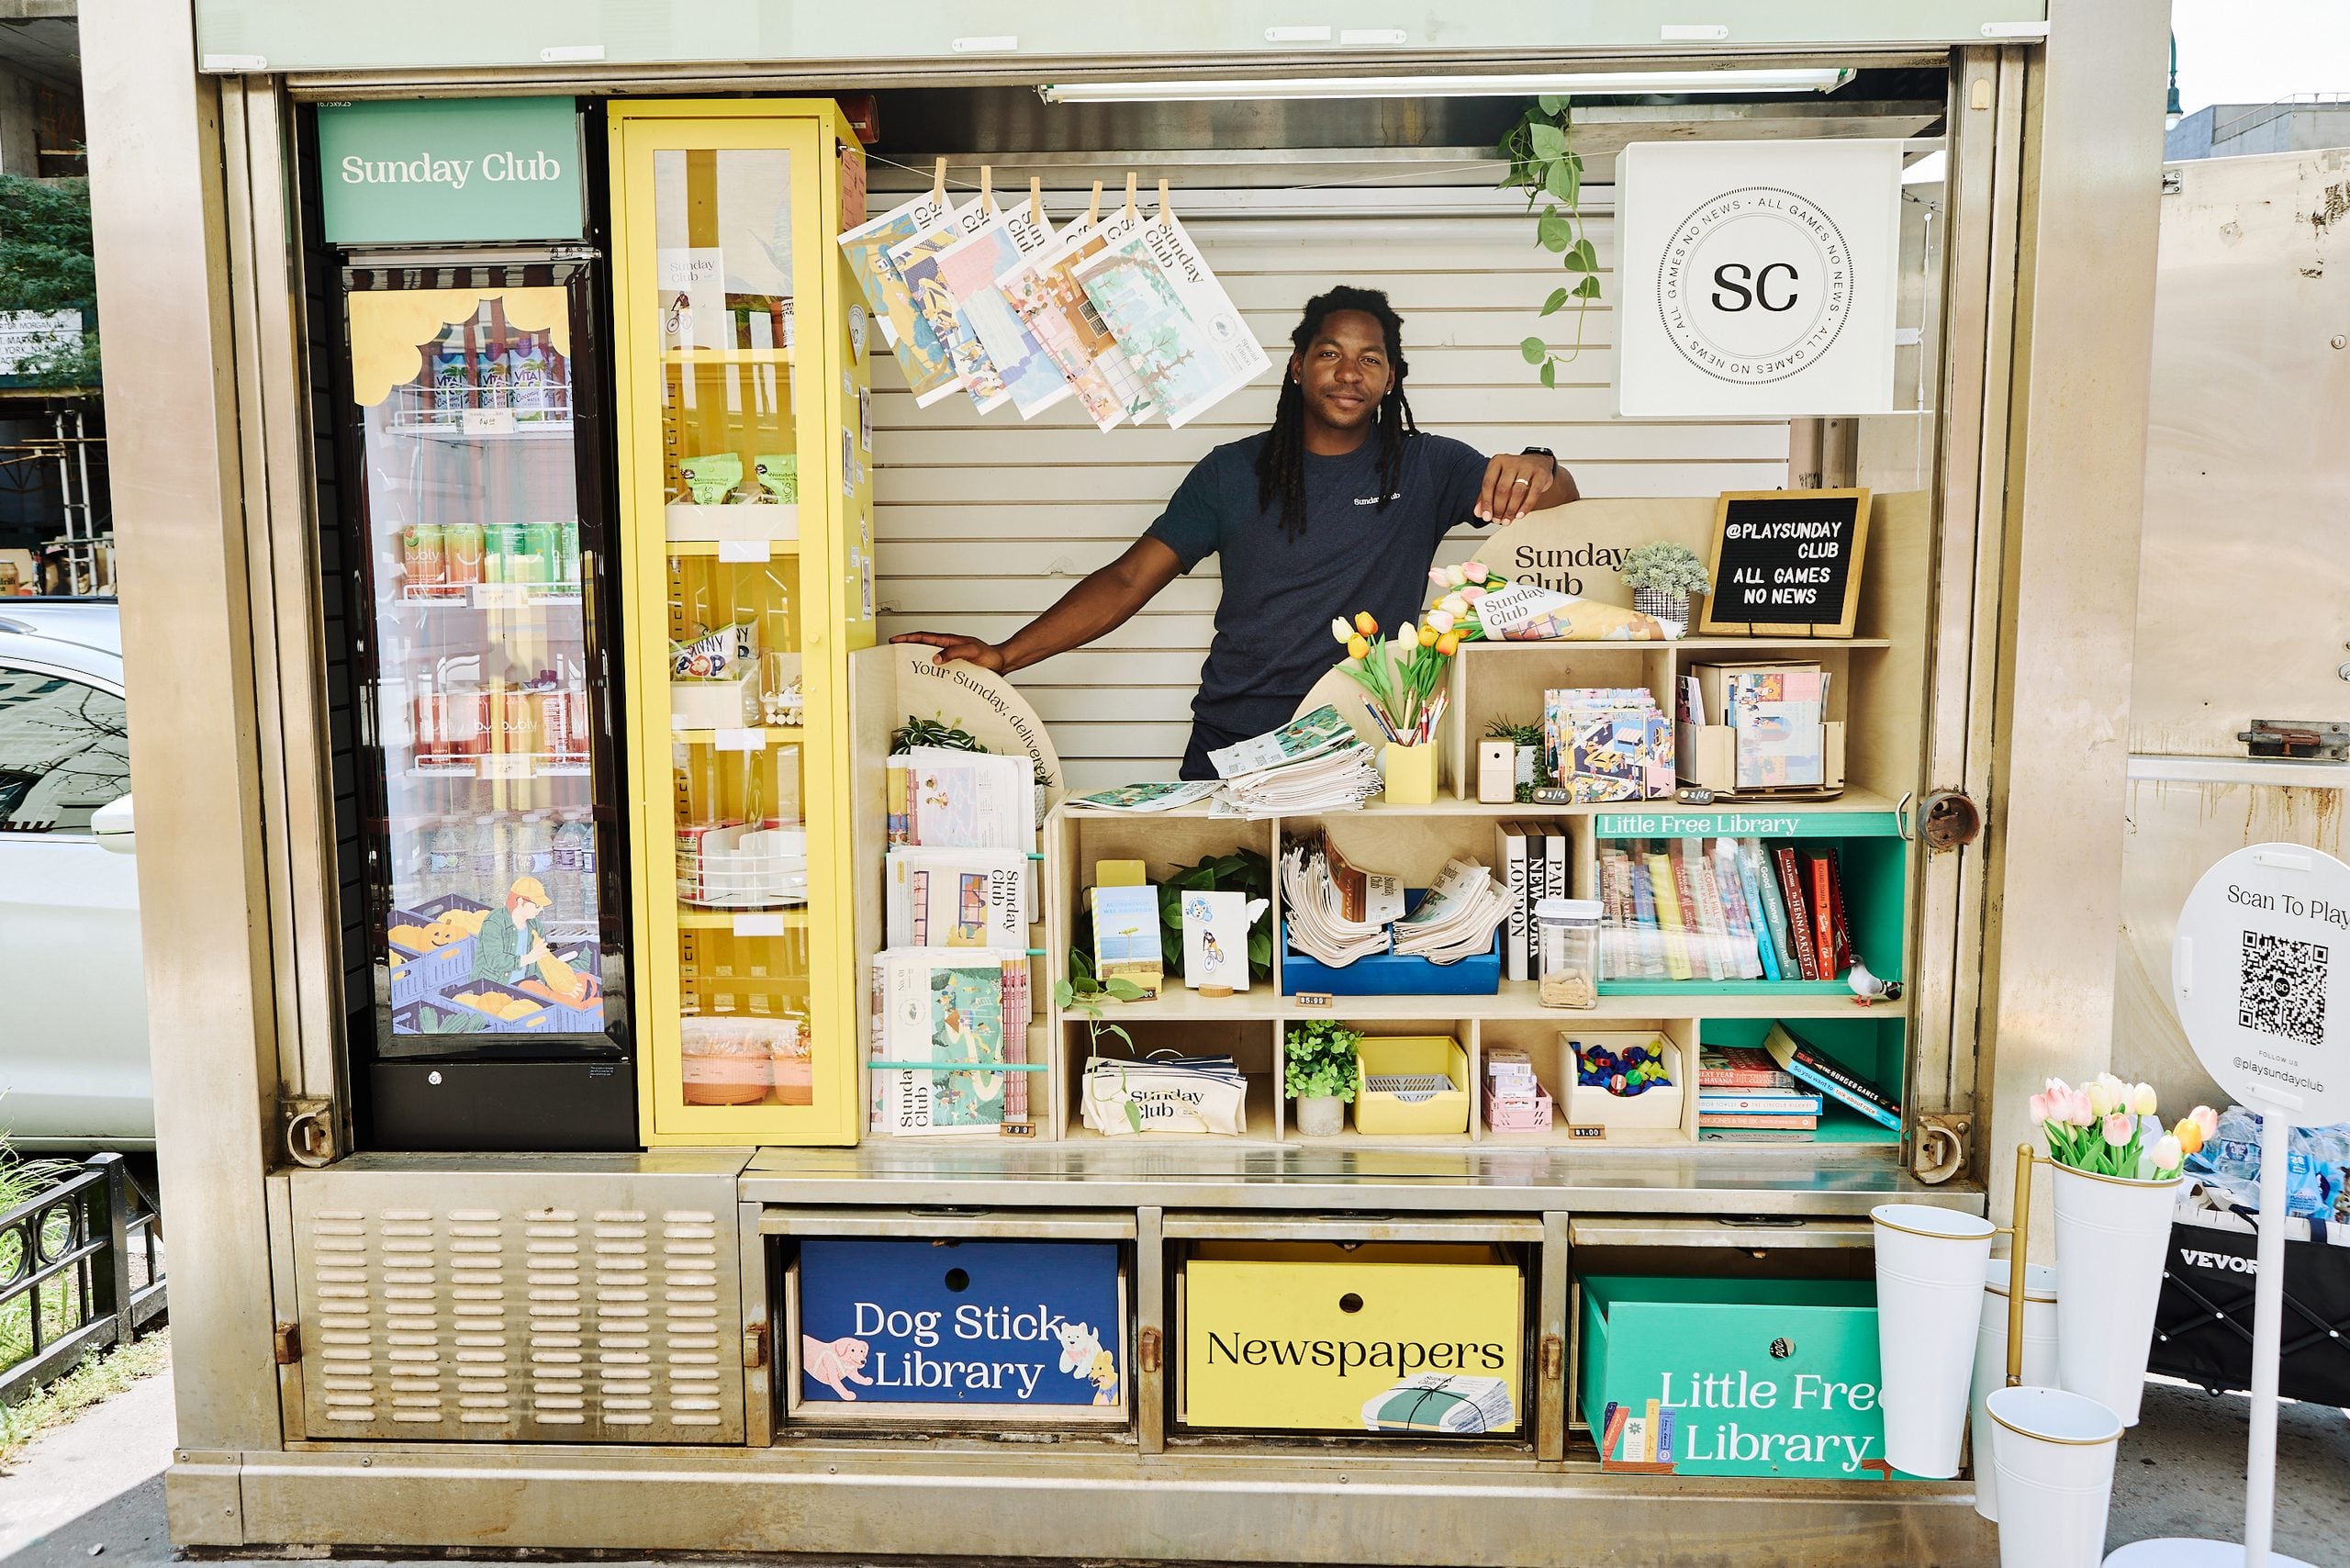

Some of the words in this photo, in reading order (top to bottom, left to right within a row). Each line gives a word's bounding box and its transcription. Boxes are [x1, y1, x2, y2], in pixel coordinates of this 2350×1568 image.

[341, 152, 474, 189] Sunday
[482, 151, 561, 182] Club
[1702, 200, 1740, 226] NEWS
[1758, 197, 1784, 210] ALL
[1683, 226, 1700, 245] NO
[1789, 205, 1830, 241] GAMES
[1145, 230, 1173, 269] Club
[1158, 223, 1203, 285] Sunday
[1827, 244, 1841, 264] NO
[670, 258, 716, 273] Sunday
[671, 272, 699, 282] Club
[1668, 248, 1685, 298] GAMES
[1712, 263, 1798, 312] SC
[1830, 271, 1843, 312] NEWS
[1670, 306, 1686, 330] ALL
[1807, 325, 1828, 348] ALL
[1690, 341, 1725, 368] NEWS
[1757, 350, 1805, 375] GAMES
[515, 369, 538, 381] VITA
[1730, 364, 1751, 375] NO
[1726, 521, 1842, 540] @PLAYSUNDAY
[1516, 542, 1631, 572] Sunday
[1797, 543, 1840, 558] CLUB
[1733, 567, 1764, 584] ALL
[1774, 567, 1831, 584] GAMES
[1485, 587, 1546, 614] Sunday
[1744, 588, 1767, 604] NO
[1771, 588, 1818, 604] NEWS
[1490, 604, 1528, 627] Club
[911, 660, 950, 678] Your
[1604, 814, 1655, 834] Little
[1662, 815, 1711, 834] Free
[1717, 814, 1800, 836] Library
[991, 869, 1005, 906] Club
[1529, 857, 1544, 901] NEW
[1002, 870, 1019, 934] Sunday
[1761, 866, 1773, 889] Good
[1768, 897, 1779, 924] Money
[2227, 884, 2275, 911] Scan
[2282, 894, 2304, 915] To
[2310, 900, 2350, 930] Play
[1792, 900, 1805, 933] HENNA
[1799, 933, 1813, 968] ARTIST
[2274, 982, 2289, 992] SC
[2258, 1049, 2286, 1064] FOLLOW
[2288, 1058, 2299, 1067] US
[1793, 1065, 1802, 1073] So
[1802, 1070, 1813, 1081] you
[1813, 1077, 1827, 1088] want
[1830, 1070, 1858, 1090] HUNGER
[1857, 1086, 1879, 1101] GAMES
[2232, 1057, 2324, 1092] @playsundayclub
[915, 1086, 928, 1126] Club
[1131, 1089, 1204, 1105] Sunday
[854, 1302, 942, 1348] Dog
[954, 1305, 1065, 1341] Stick
[1207, 1331, 1505, 1379] Newspapers
[875, 1350, 1046, 1399] Library
[1660, 1370, 1777, 1409] Little
[1685, 1423, 1874, 1473] Library
